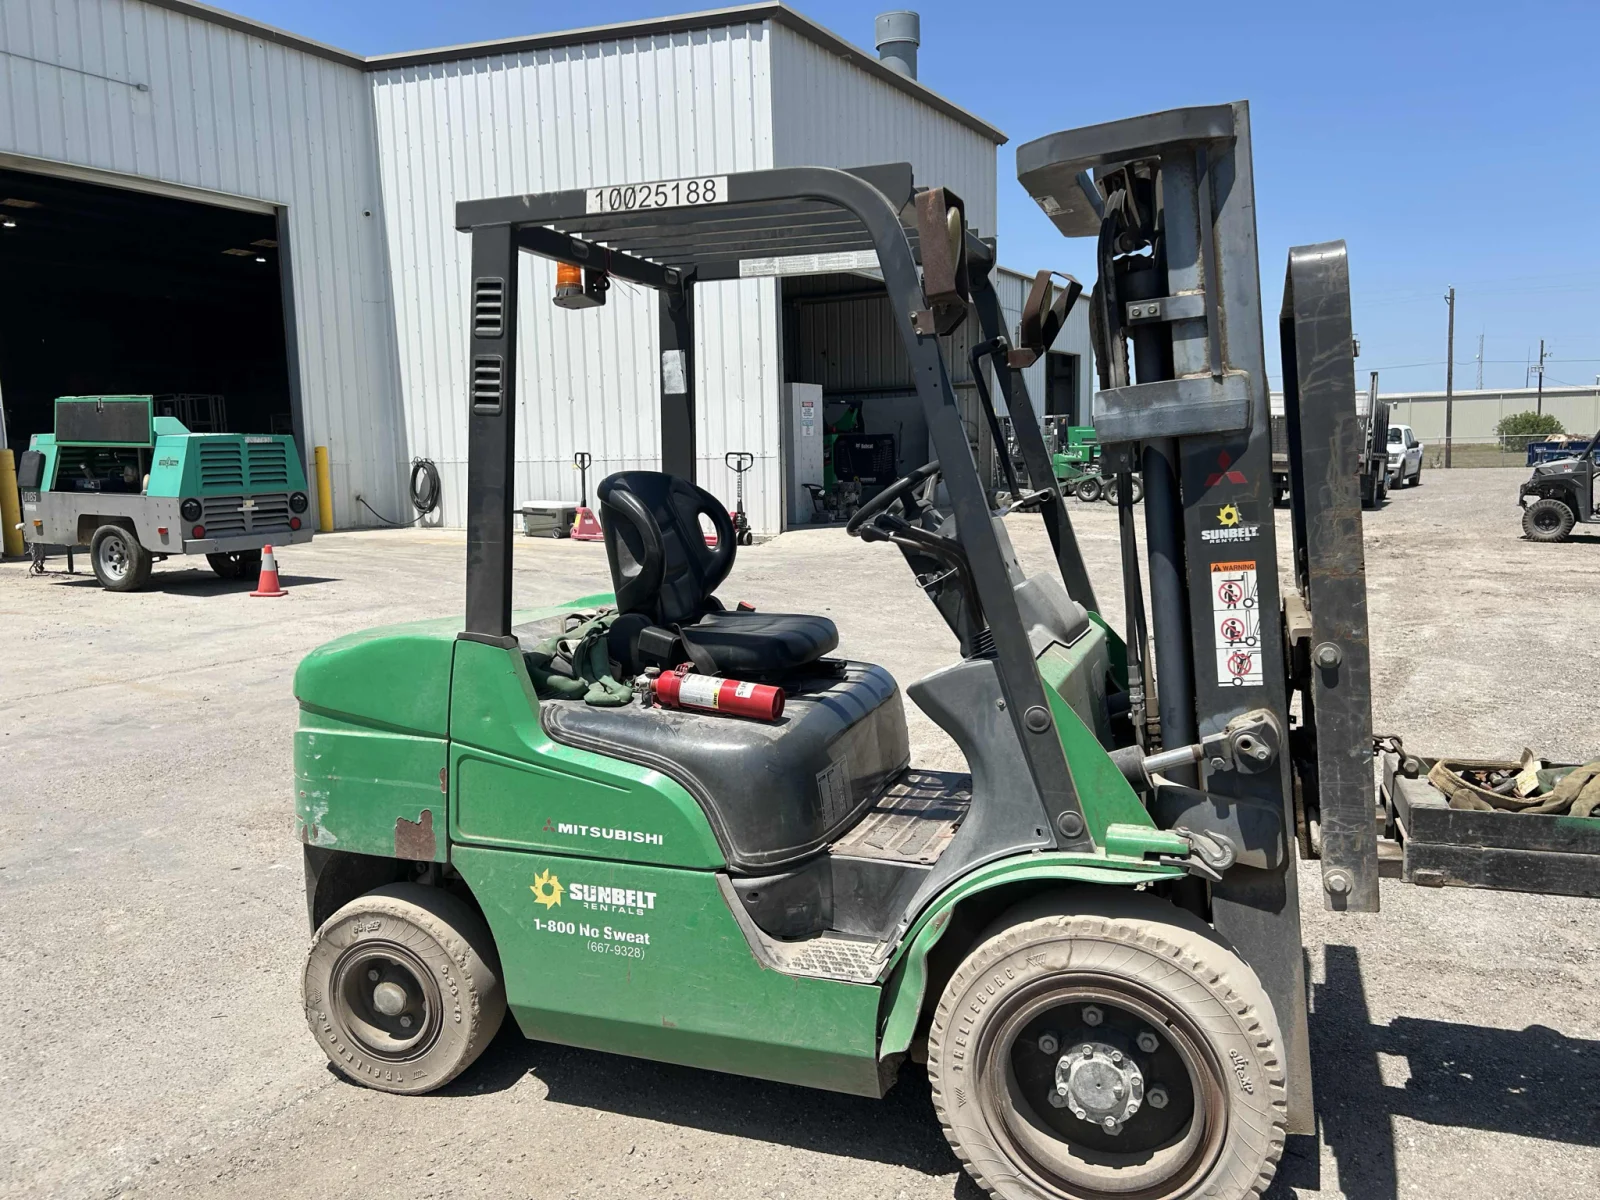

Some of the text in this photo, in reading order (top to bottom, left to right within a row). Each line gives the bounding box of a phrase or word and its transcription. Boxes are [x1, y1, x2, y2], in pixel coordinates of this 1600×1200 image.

[595, 179, 717, 211] 10025188
[1202, 526, 1257, 540] SUNBELT
[1222, 563, 1255, 572] WARNING
[558, 822, 663, 846] MITSUBISHI
[569, 883, 657, 910] SUNBELT
[583, 902, 644, 916] RENTALS
[533, 918, 651, 945] 1-800 No Sweat
[587, 940, 645, 960] (667-9328)
[953, 967, 1016, 1073] TRELLEBORG
